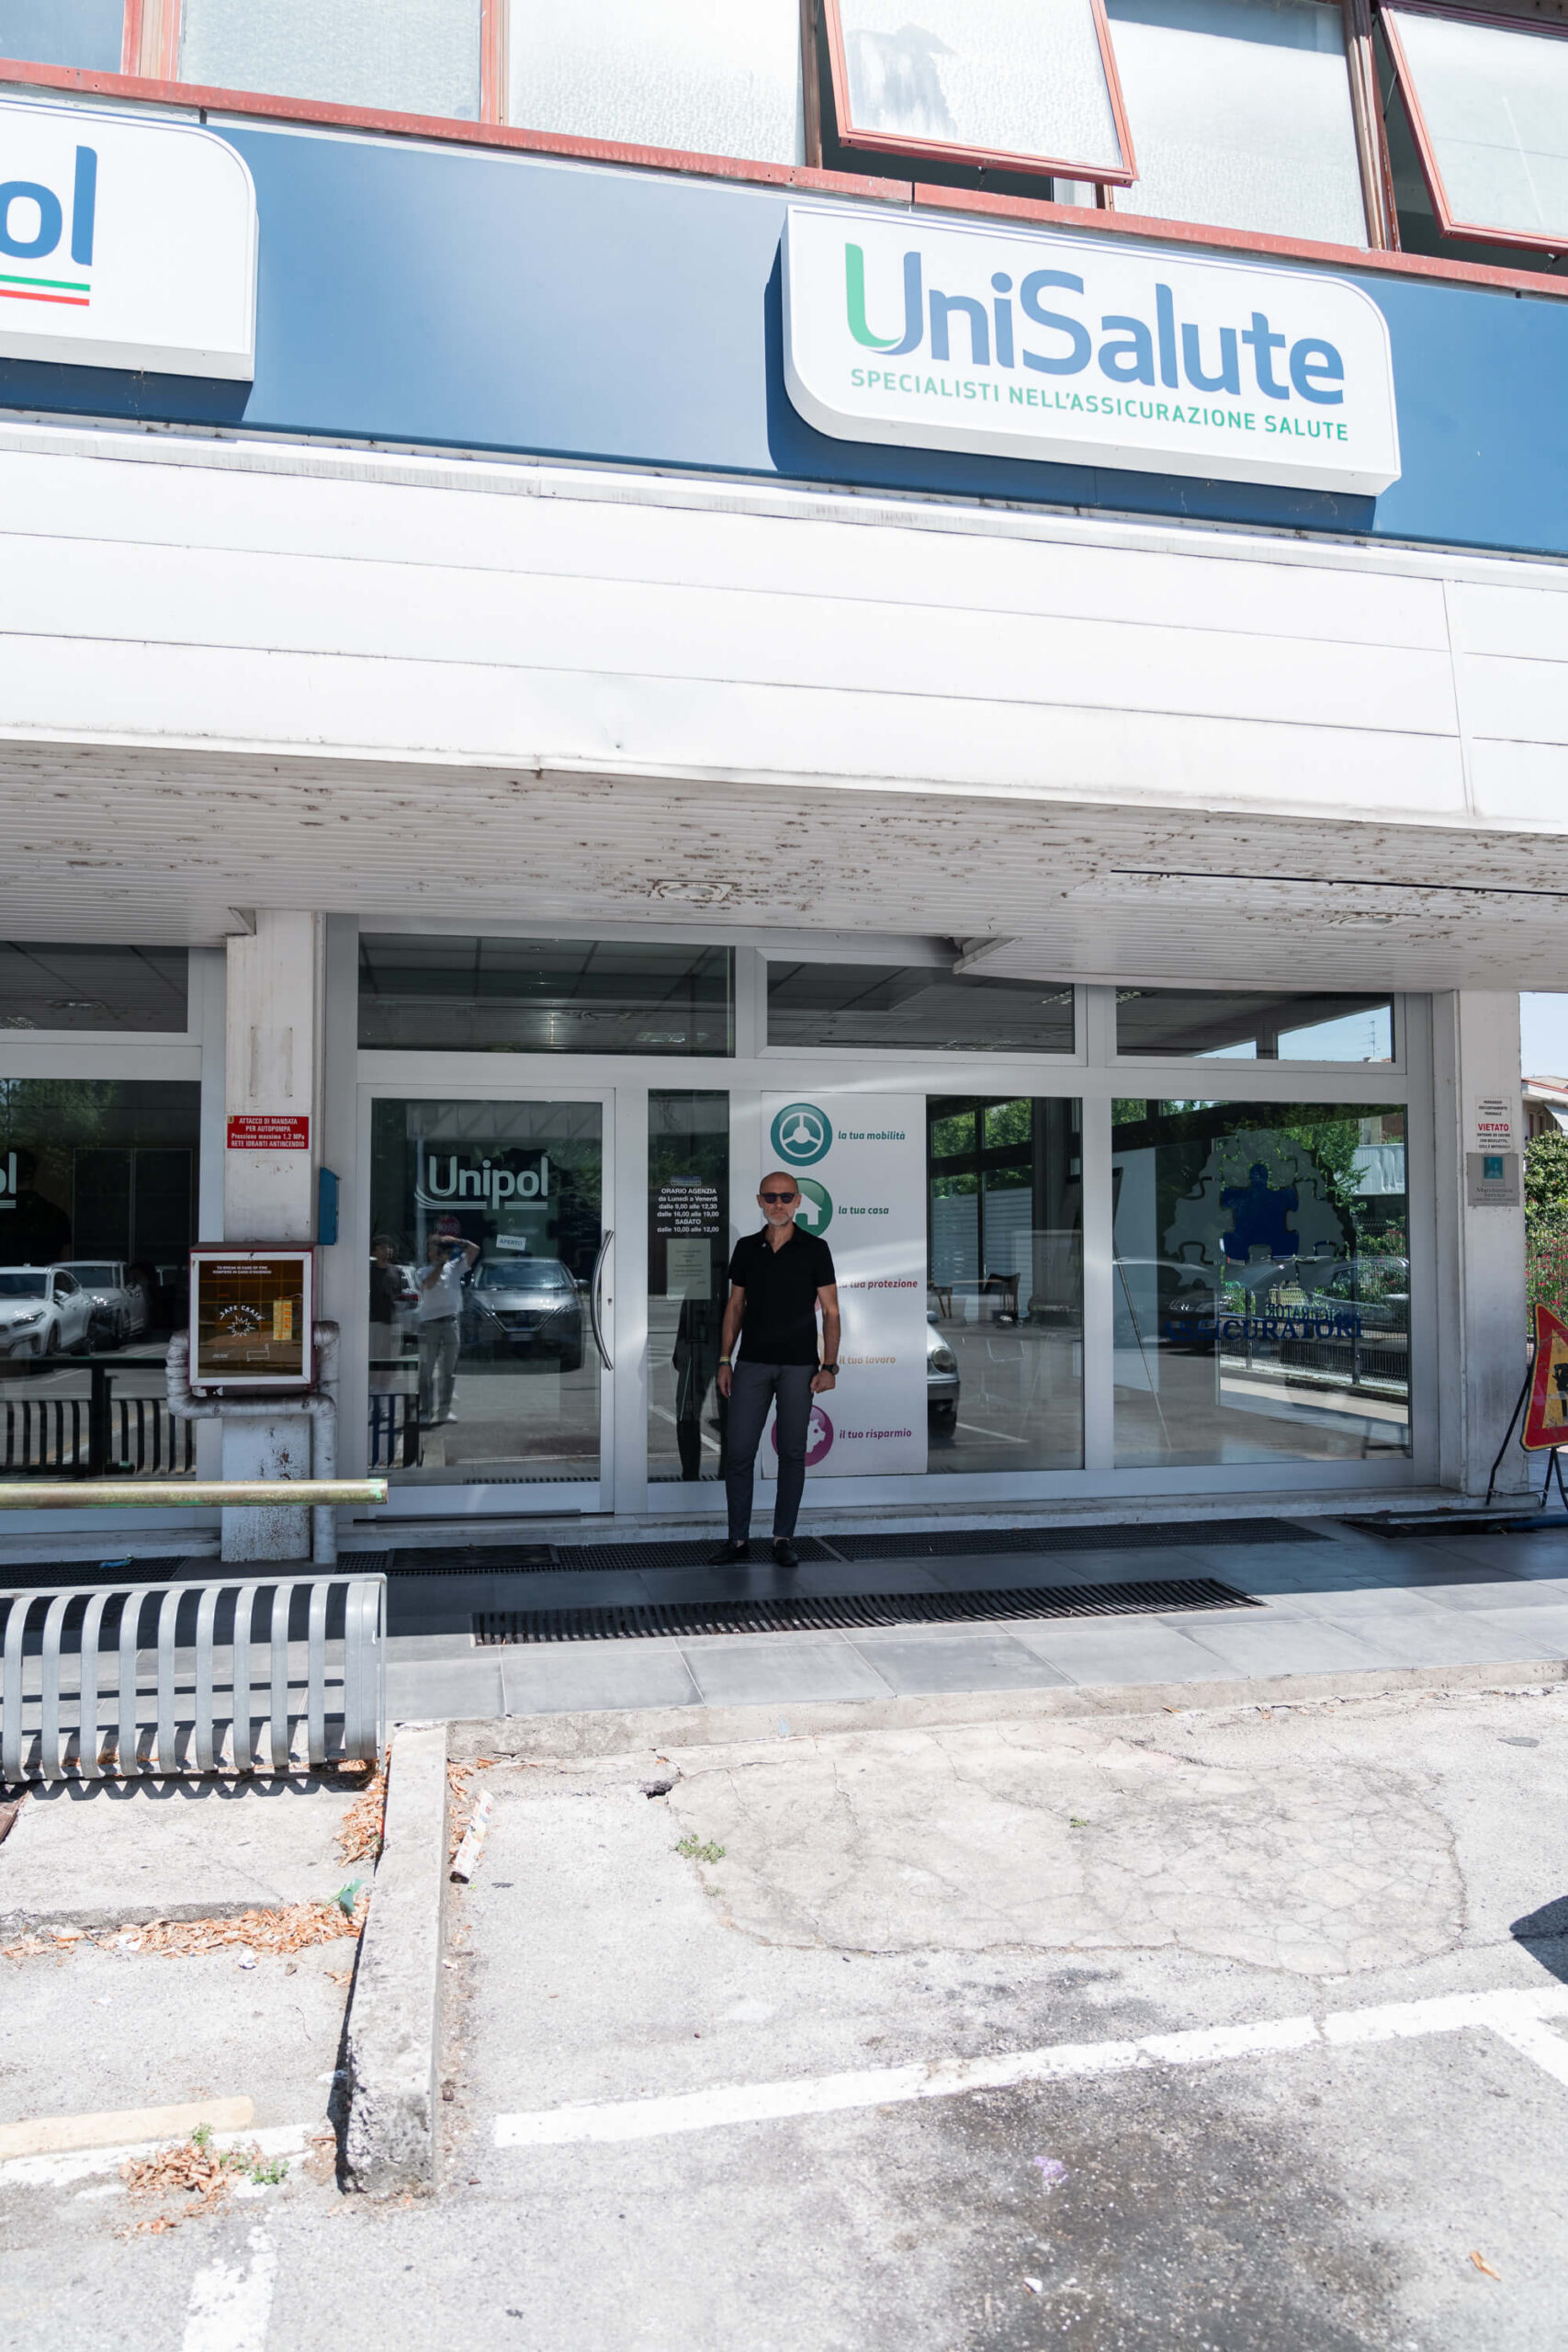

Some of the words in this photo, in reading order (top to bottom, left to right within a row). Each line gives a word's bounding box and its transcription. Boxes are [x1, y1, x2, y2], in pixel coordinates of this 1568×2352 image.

[0, 144, 98, 267] ol
[844, 243, 1346, 405] UniSalute
[851, 368, 1000, 403] SPECIALISTI
[1009, 385, 1257, 432] NELL'ASSICURAZIONE
[1264, 414, 1349, 442] SALUTE
[1477, 1123, 1509, 1132] VIETATO
[838, 1131, 847, 1139] la
[866, 1130, 906, 1140] mobilità
[429, 1155, 549, 1210] Unipol
[838, 1205, 847, 1214] la
[866, 1279, 919, 1290] protezione
[1160, 1318, 1363, 1341] ASSICURATORI
[839, 1355, 845, 1364] il
[848, 1356, 863, 1364] tuo
[865, 1356, 896, 1364] lavoro
[840, 1430, 845, 1439] il
[848, 1430, 863, 1439] tuo
[865, 1428, 912, 1440] risparmio
